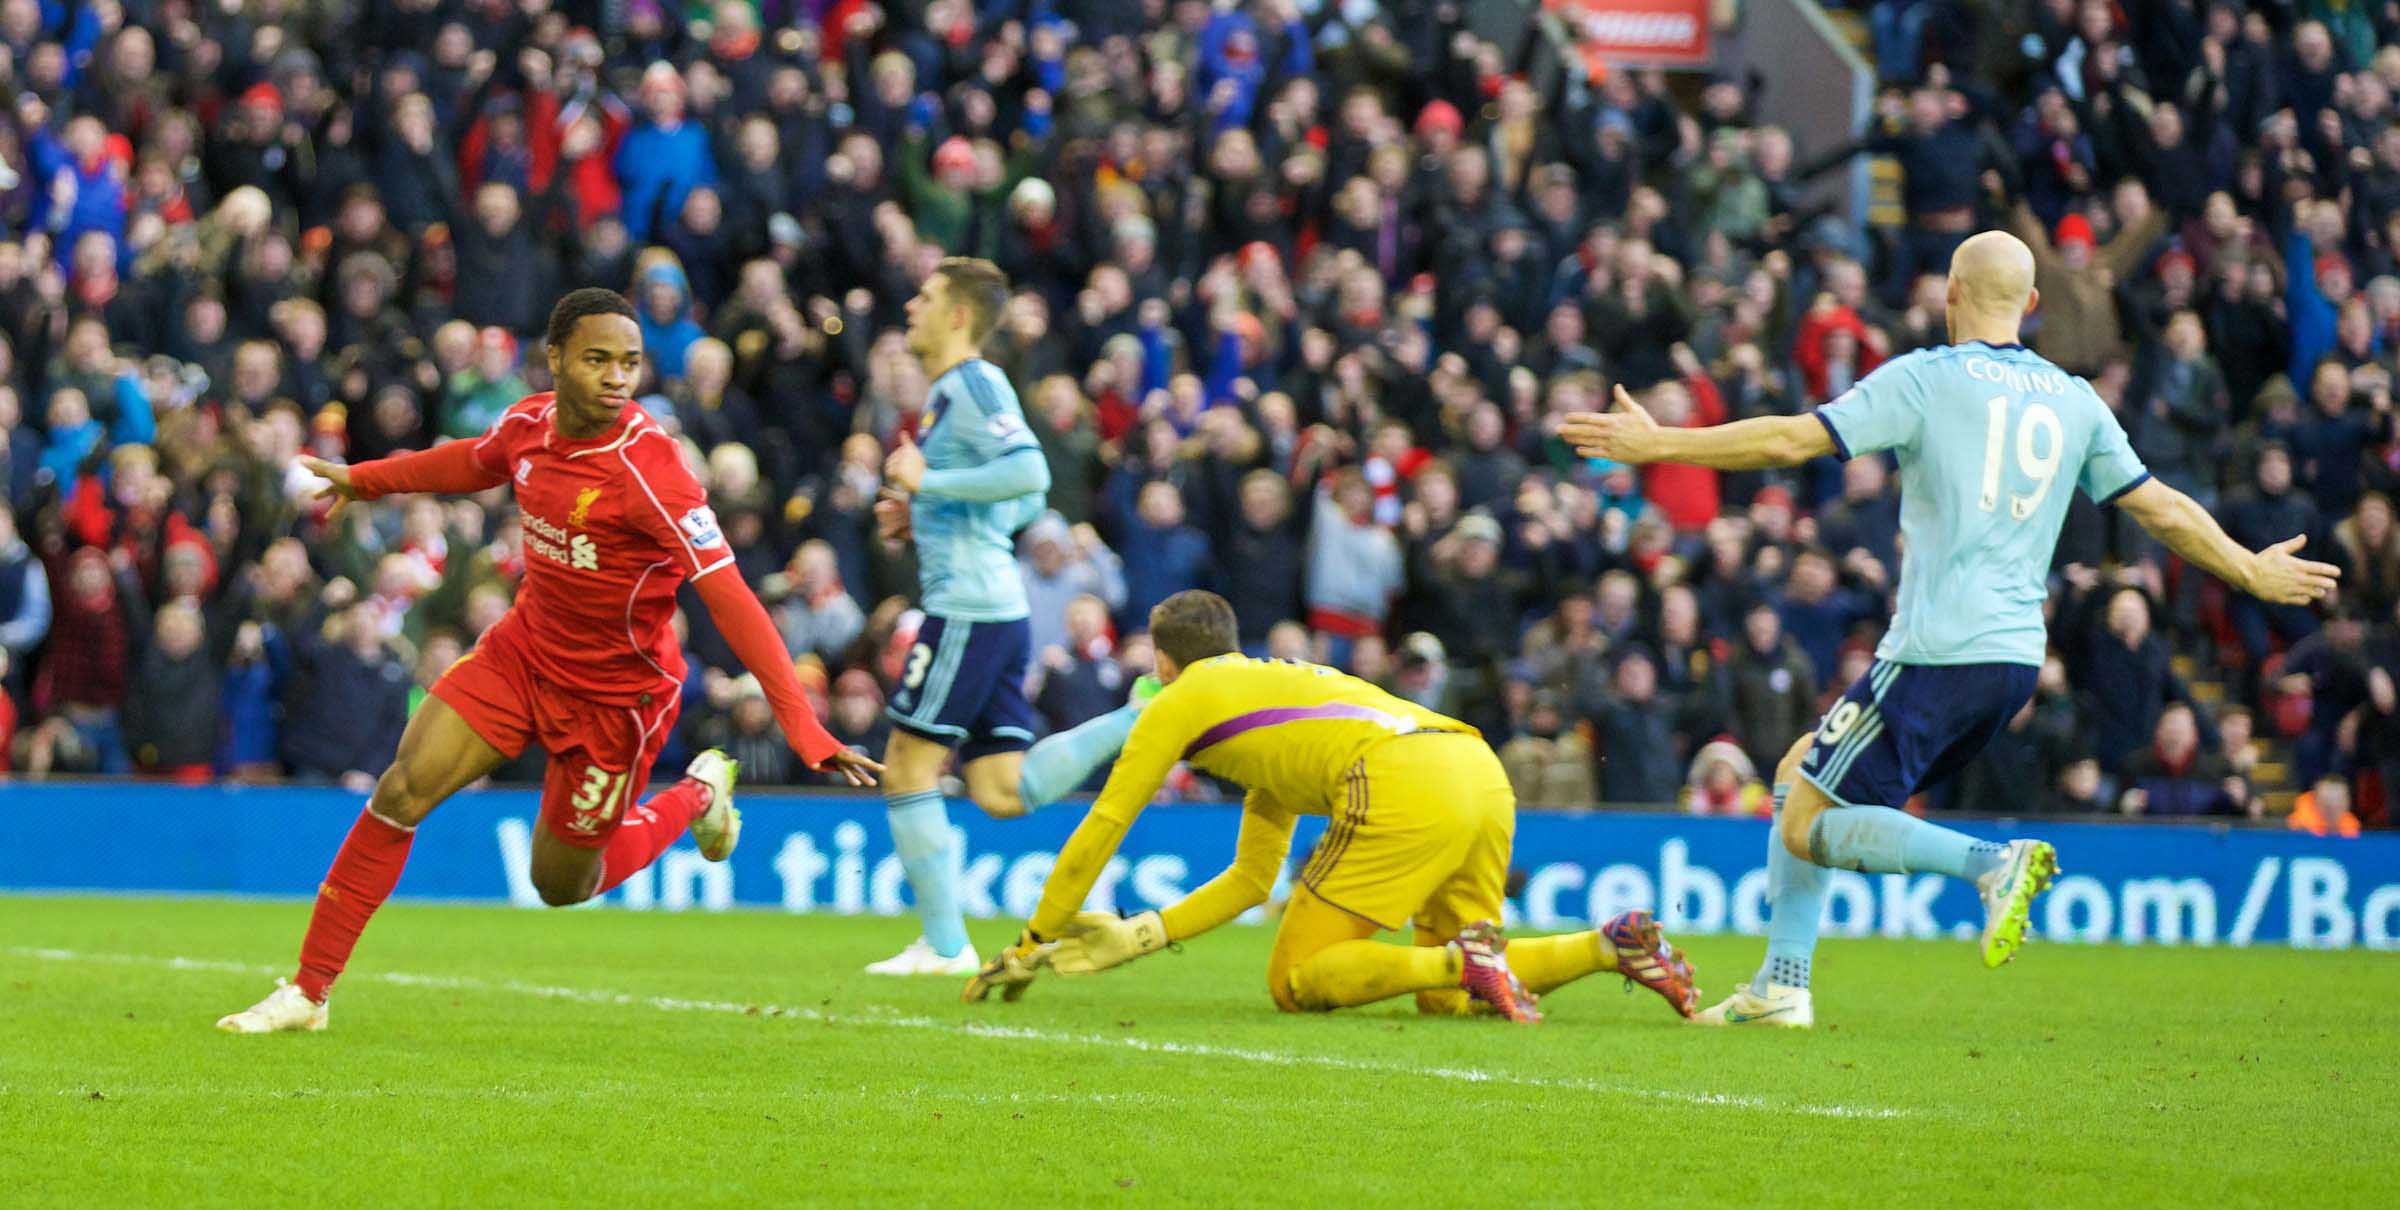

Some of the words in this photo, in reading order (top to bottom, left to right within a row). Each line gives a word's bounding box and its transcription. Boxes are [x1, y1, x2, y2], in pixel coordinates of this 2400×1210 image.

[1978, 393, 2065, 521] 19
[903, 642, 933, 689] 3
[571, 765, 628, 821] 31
